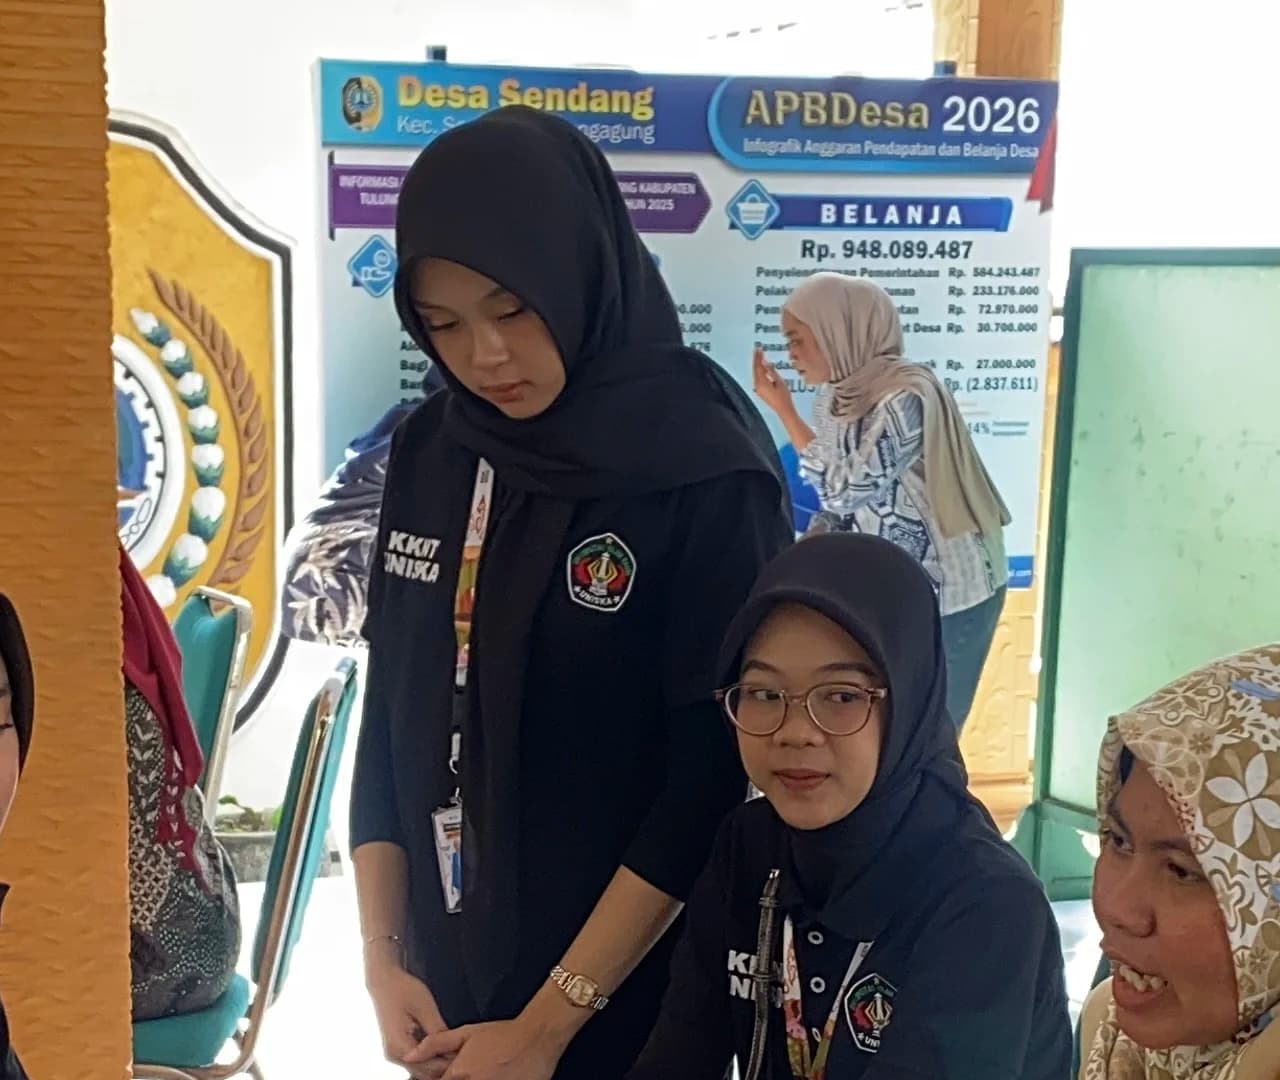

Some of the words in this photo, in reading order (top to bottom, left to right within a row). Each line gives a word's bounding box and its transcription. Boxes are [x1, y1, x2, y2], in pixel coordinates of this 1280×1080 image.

[398, 75, 488, 109] Desa
[498, 78, 655, 121] Sendang
[744, 90, 929, 128] APBDesa
[942, 96, 1040, 133] 2026
[397, 115, 437, 134] Kec.
[577, 123, 656, 144] ngagung
[743, 138, 801, 156] Infografik
[804, 139, 861, 157] Anggaran
[863, 140, 936, 158] Pendapatan
[938, 142, 960, 156] dan
[963, 142, 1007, 160] Belanja
[1010, 143, 1039, 157] Desa
[820, 203, 962, 226] BELANJA
[801, 240, 836, 263] Rp.
[843, 240, 973, 260] 948.089.487
[948, 267, 966, 279] Rp.
[948, 286, 966, 297] Rp.
[948, 304, 966, 315] Rp.
[913, 323, 941, 333] Desa
[946, 323, 965, 334] Rp.
[946, 360, 964, 370] Rp.
[966, 377, 1038, 392] (2.837.611)
